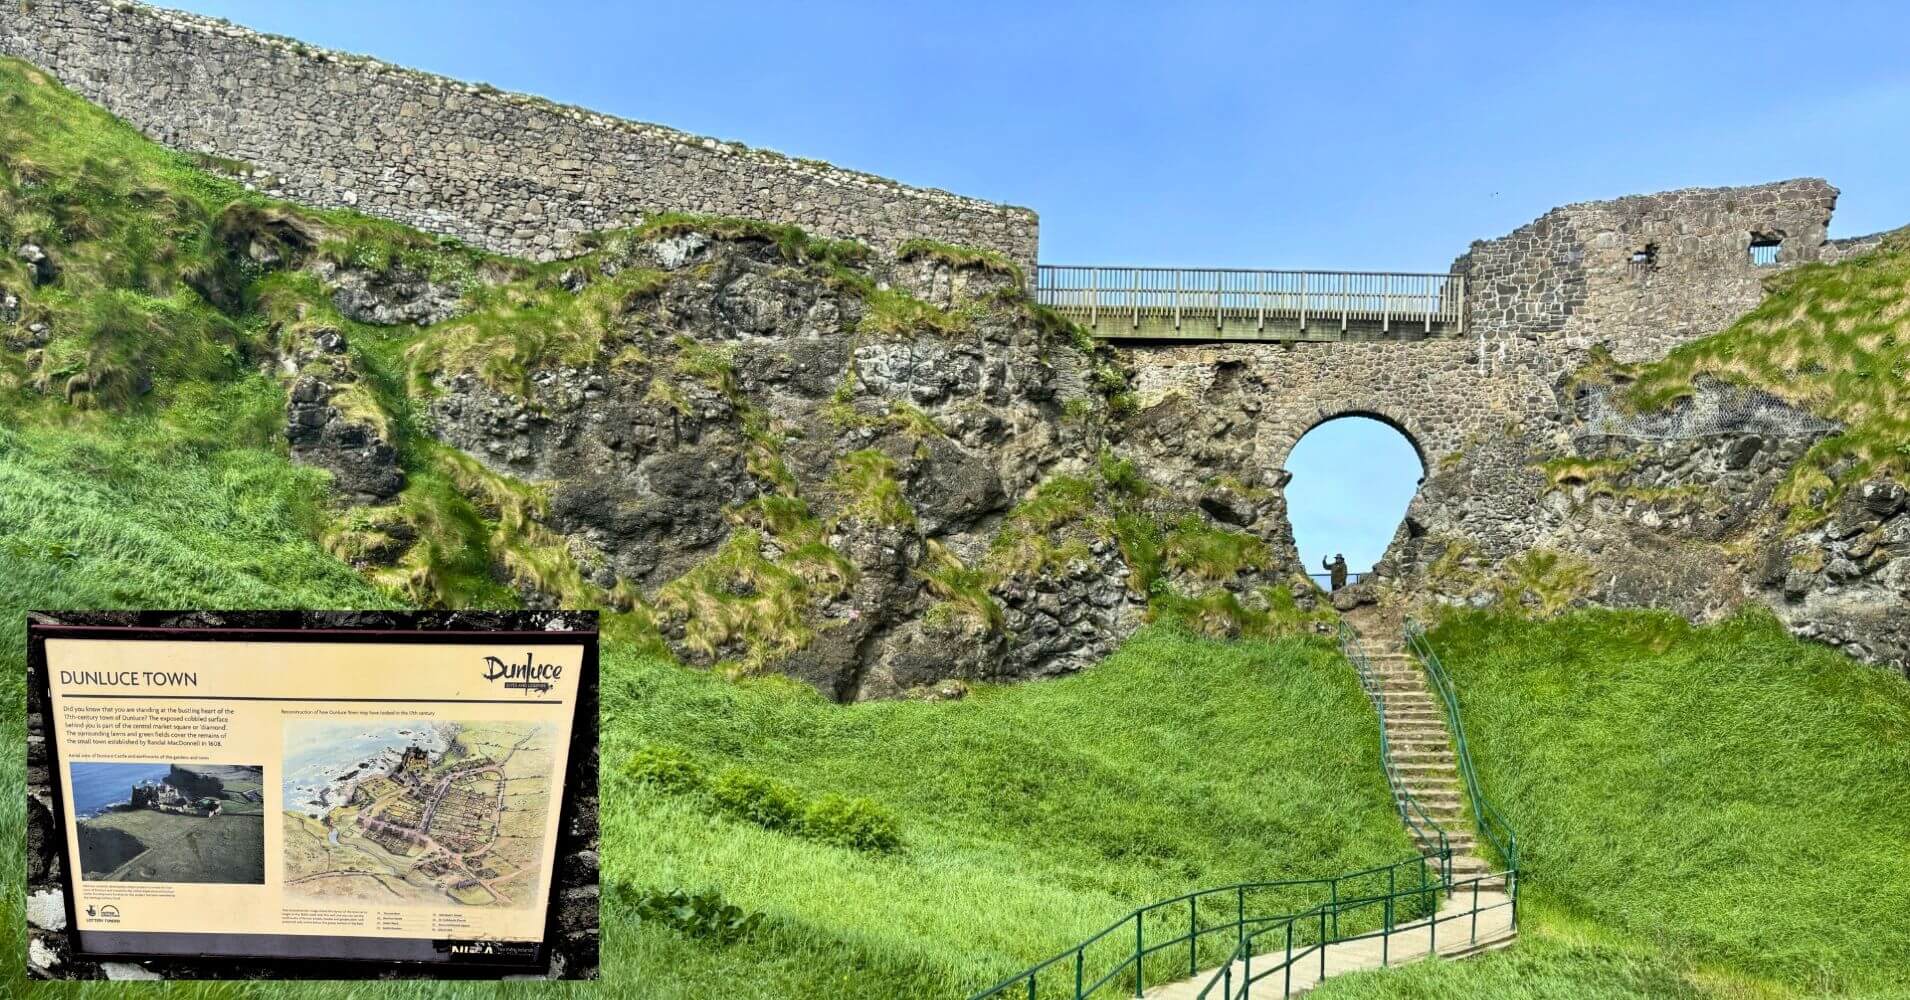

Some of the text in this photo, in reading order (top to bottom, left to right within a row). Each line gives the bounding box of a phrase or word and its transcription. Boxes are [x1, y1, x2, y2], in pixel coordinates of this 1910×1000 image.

[60, 670, 197, 687] DUNLUCE TOWN
[482, 652, 562, 695] Dunluce
